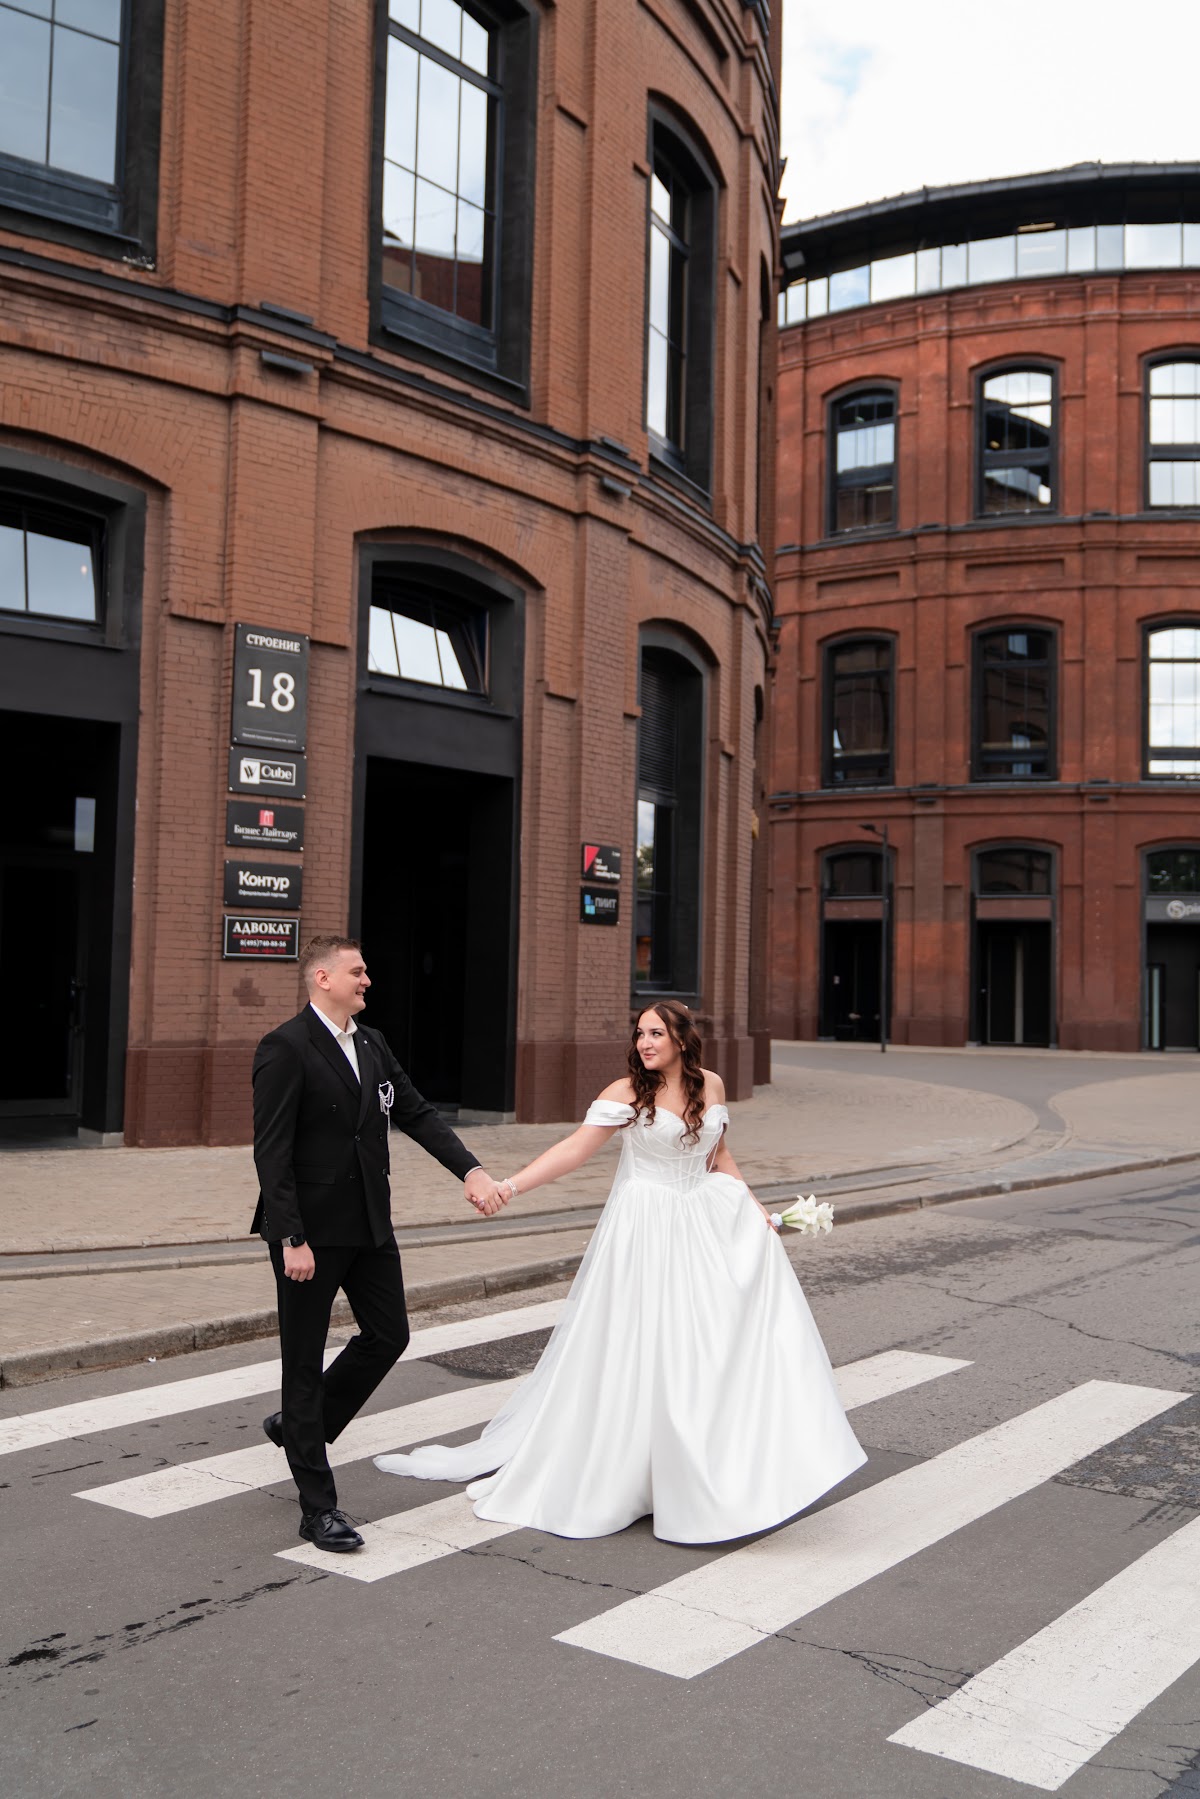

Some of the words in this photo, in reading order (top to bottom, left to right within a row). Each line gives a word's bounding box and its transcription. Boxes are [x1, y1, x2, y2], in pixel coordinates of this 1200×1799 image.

[246, 633, 300, 652] СТРОЕНИЕ
[247, 669, 295, 712] 18
[261, 765, 292, 780] Cube
[234, 824, 261, 836] Бизнес
[262, 827, 298, 840] Лайтхаус
[238, 871, 290, 891] Контур
[232, 921, 292, 935] АДВОКАТ
